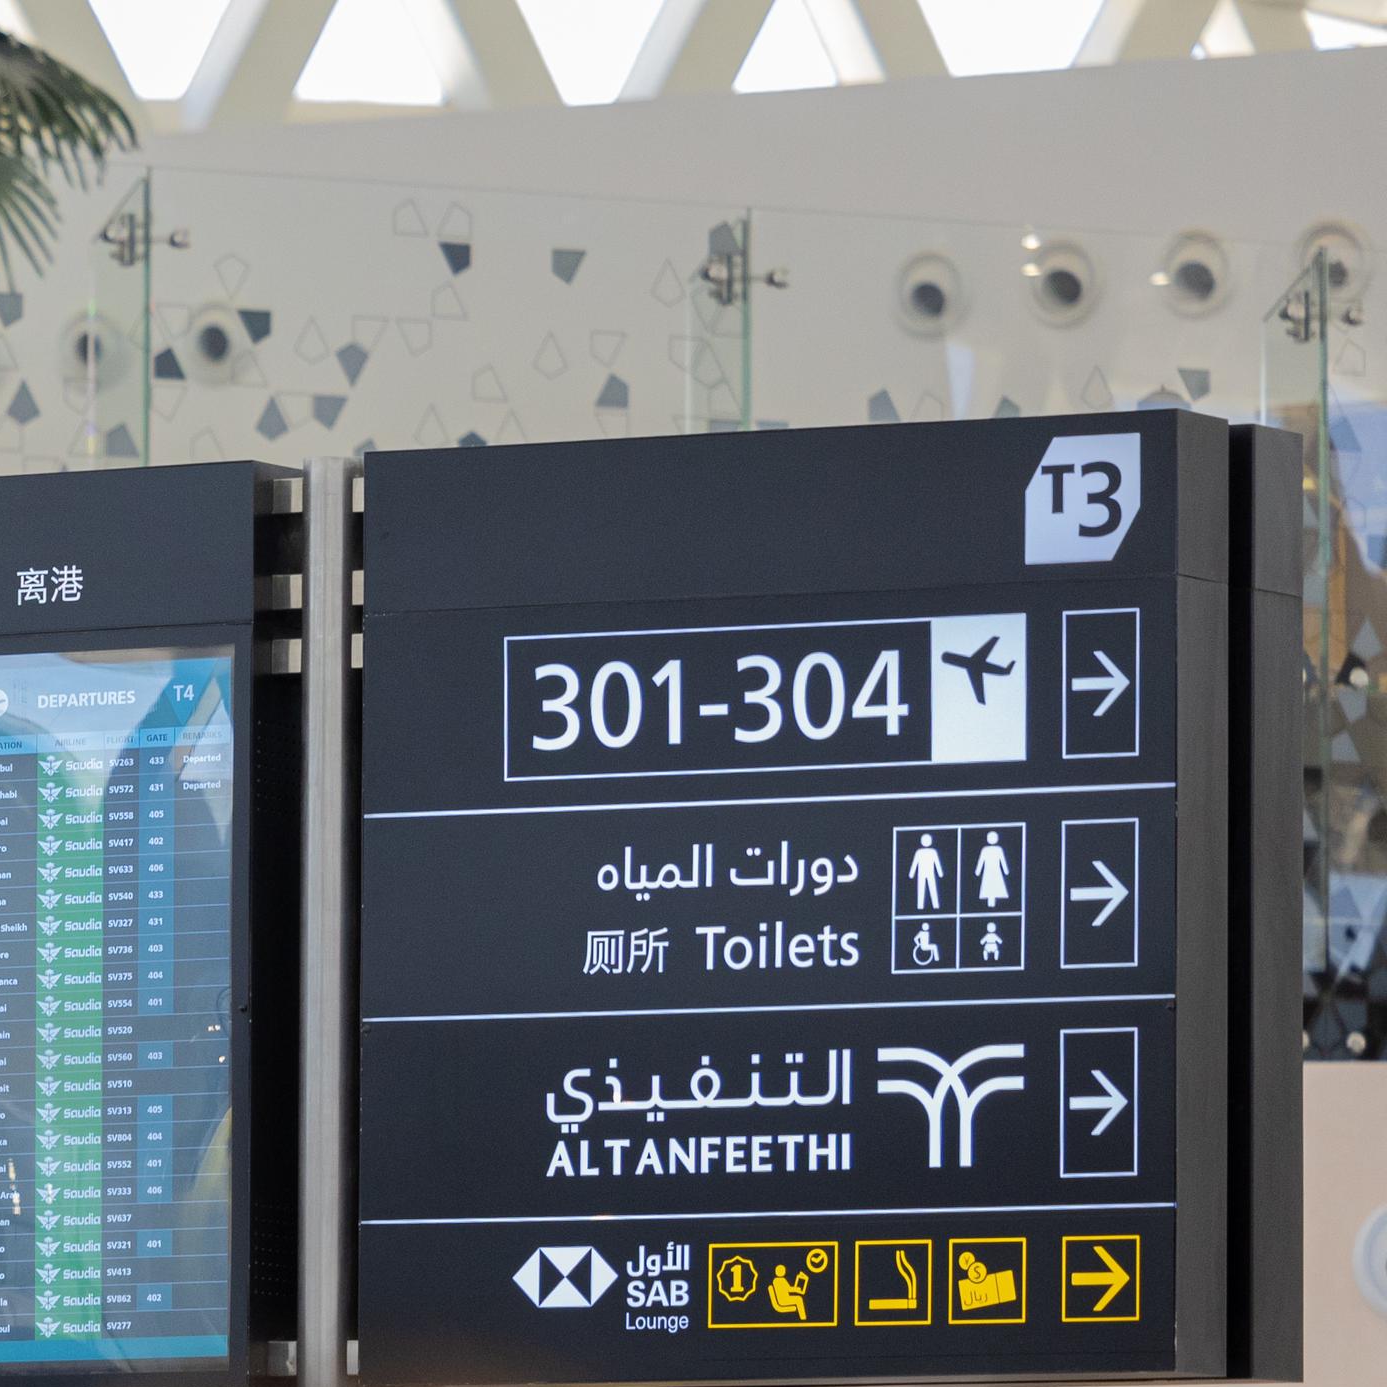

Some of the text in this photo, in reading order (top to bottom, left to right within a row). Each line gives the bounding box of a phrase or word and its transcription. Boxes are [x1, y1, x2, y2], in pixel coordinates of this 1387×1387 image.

[1041, 461, 1122, 537] T3
[17, 565, 83, 605] 离港
[38, 685, 194, 708] DEPARTURES T4
[533, 650, 909, 750] 301-304
[598, 841, 858, 901] دورات المياه
[583, 921, 859, 975] 厕所 Toilets
[547, 1049, 851, 1133] التنفيذي
[546, 1133, 850, 1177] ALTANFEETHI
[627, 1242, 689, 1277] الأول
[63, 1294, 100, 1306] Saudia
[107, 1295, 131, 1303] SV862
[627, 1280, 689, 1307] SAB
[626, 1312, 689, 1333] Lounge
